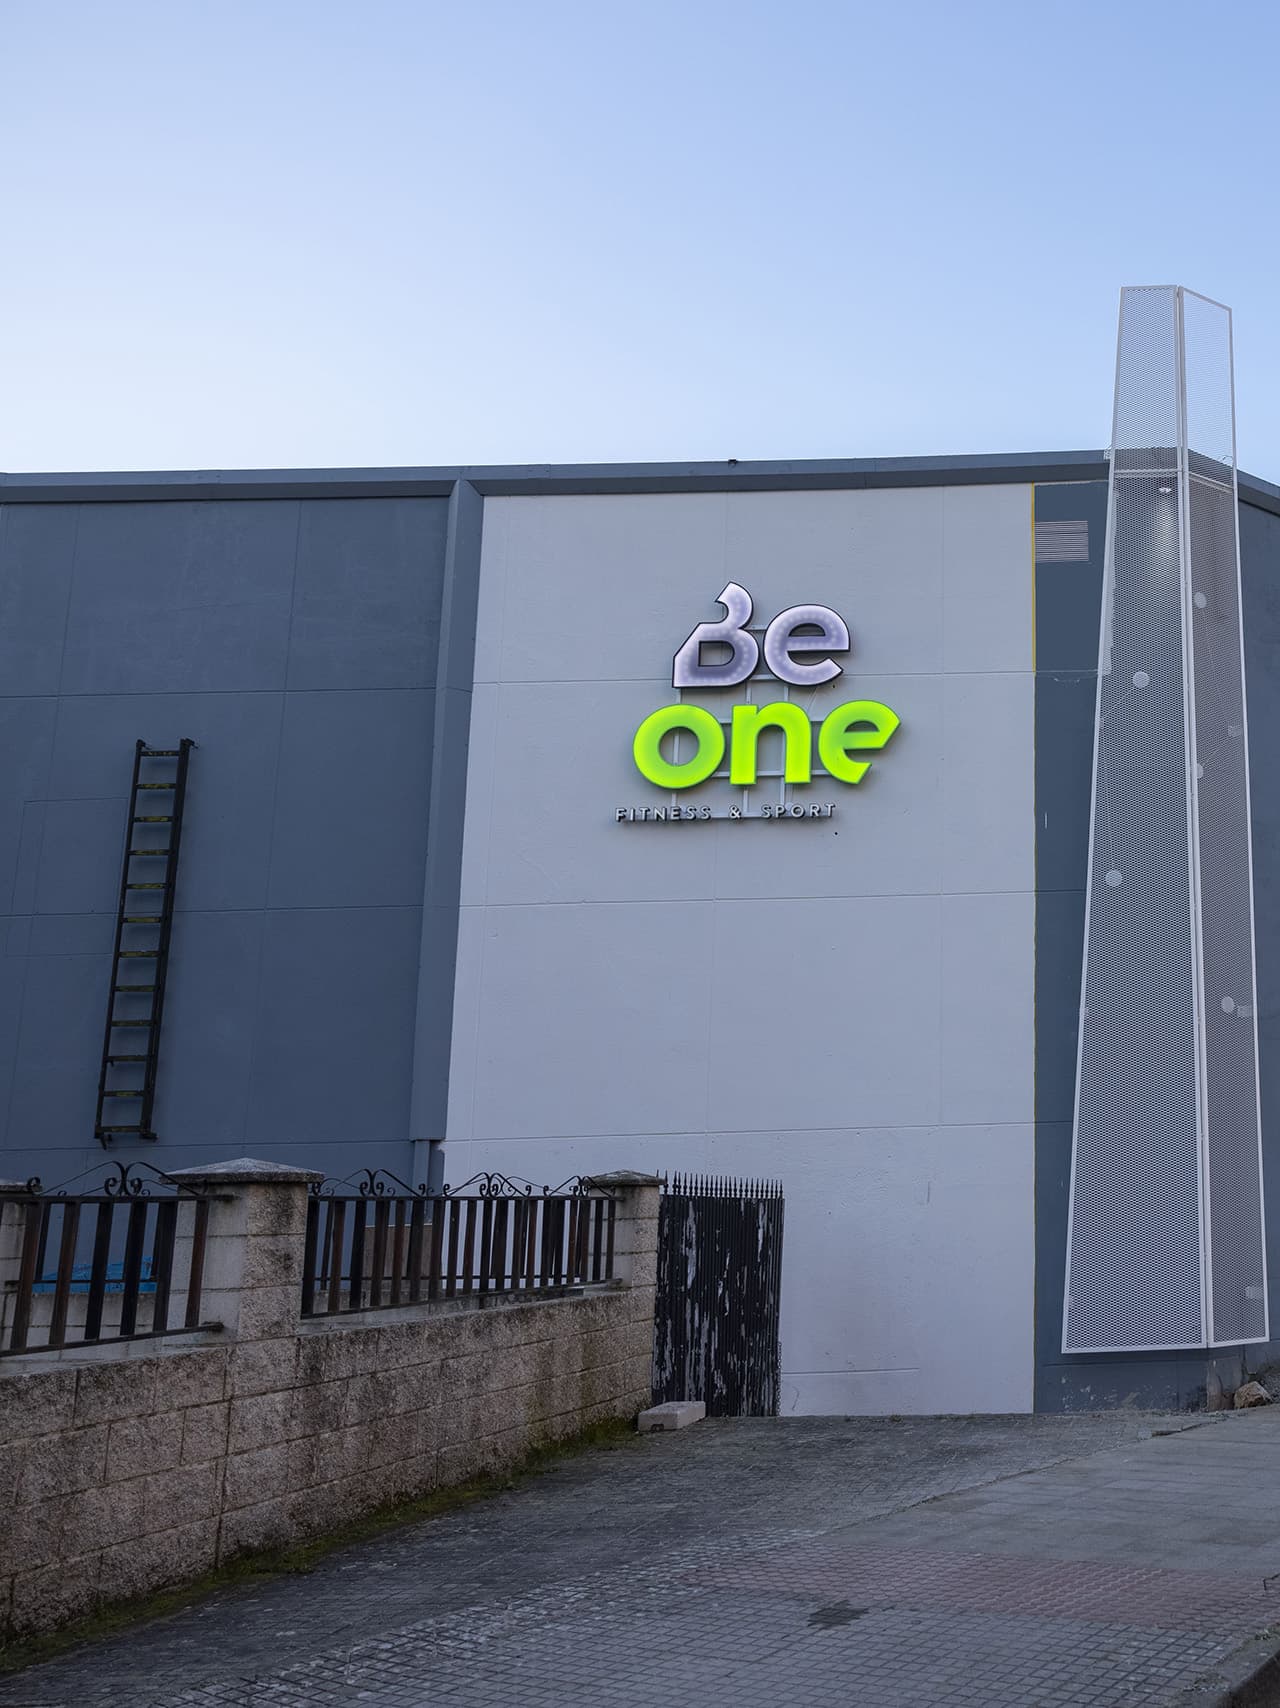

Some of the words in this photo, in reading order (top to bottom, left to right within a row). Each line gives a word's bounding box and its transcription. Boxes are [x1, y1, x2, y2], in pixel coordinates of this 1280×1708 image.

[672, 581, 850, 688] Be
[633, 699, 900, 789] one
[615, 805, 712, 822] FITNESS
[729, 804, 742, 820] &
[760, 803, 836, 819] SPORT
